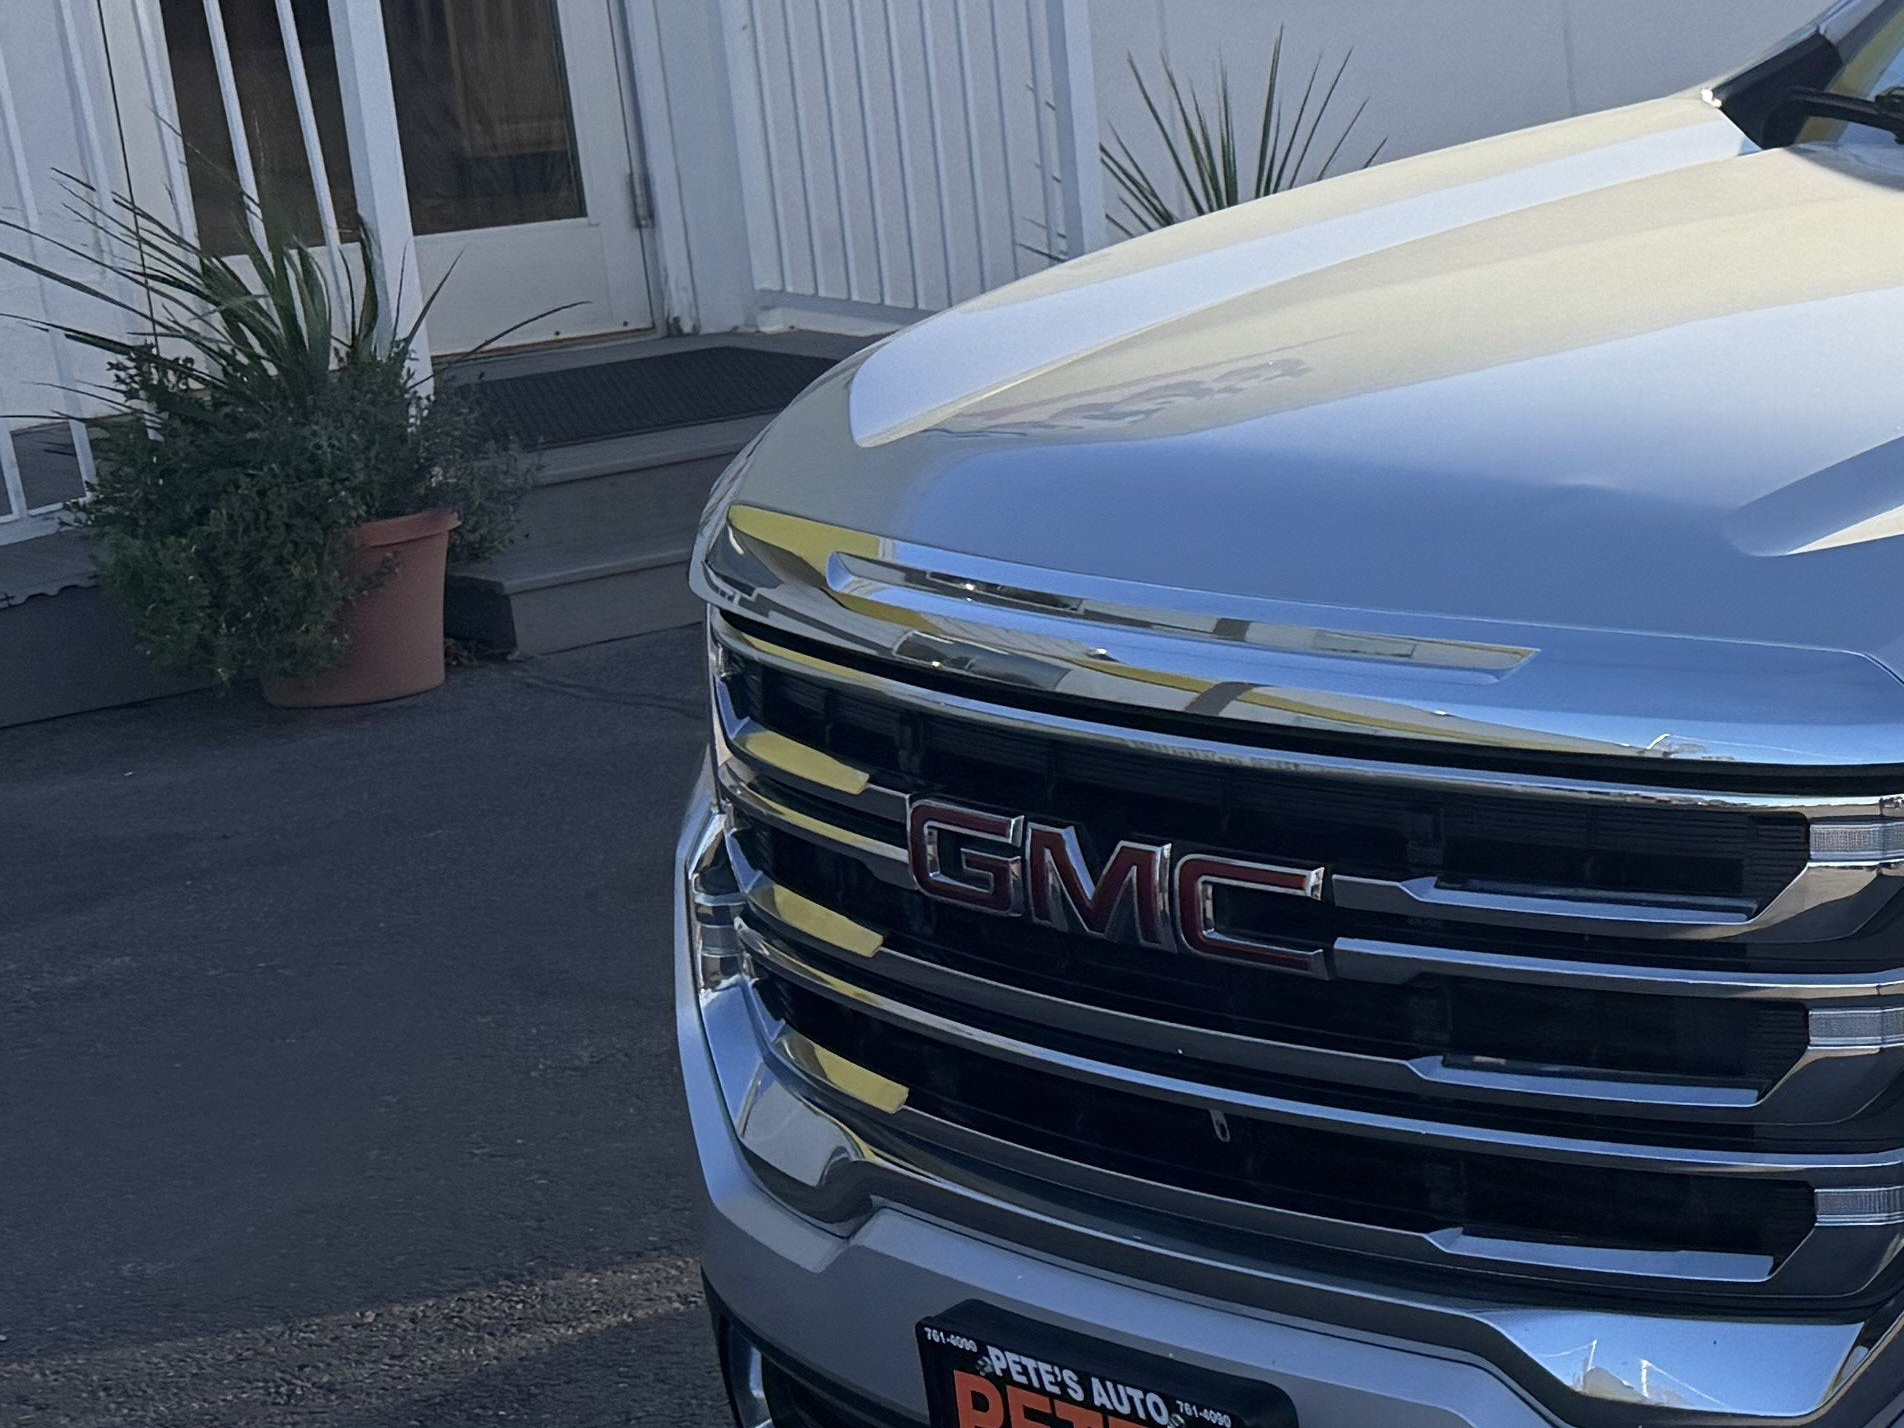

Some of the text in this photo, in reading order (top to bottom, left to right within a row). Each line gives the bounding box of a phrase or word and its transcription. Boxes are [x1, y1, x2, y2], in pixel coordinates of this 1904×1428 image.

[906, 796, 1330, 980] GMC
[985, 1344, 1169, 1426] PETE'S AUTO
